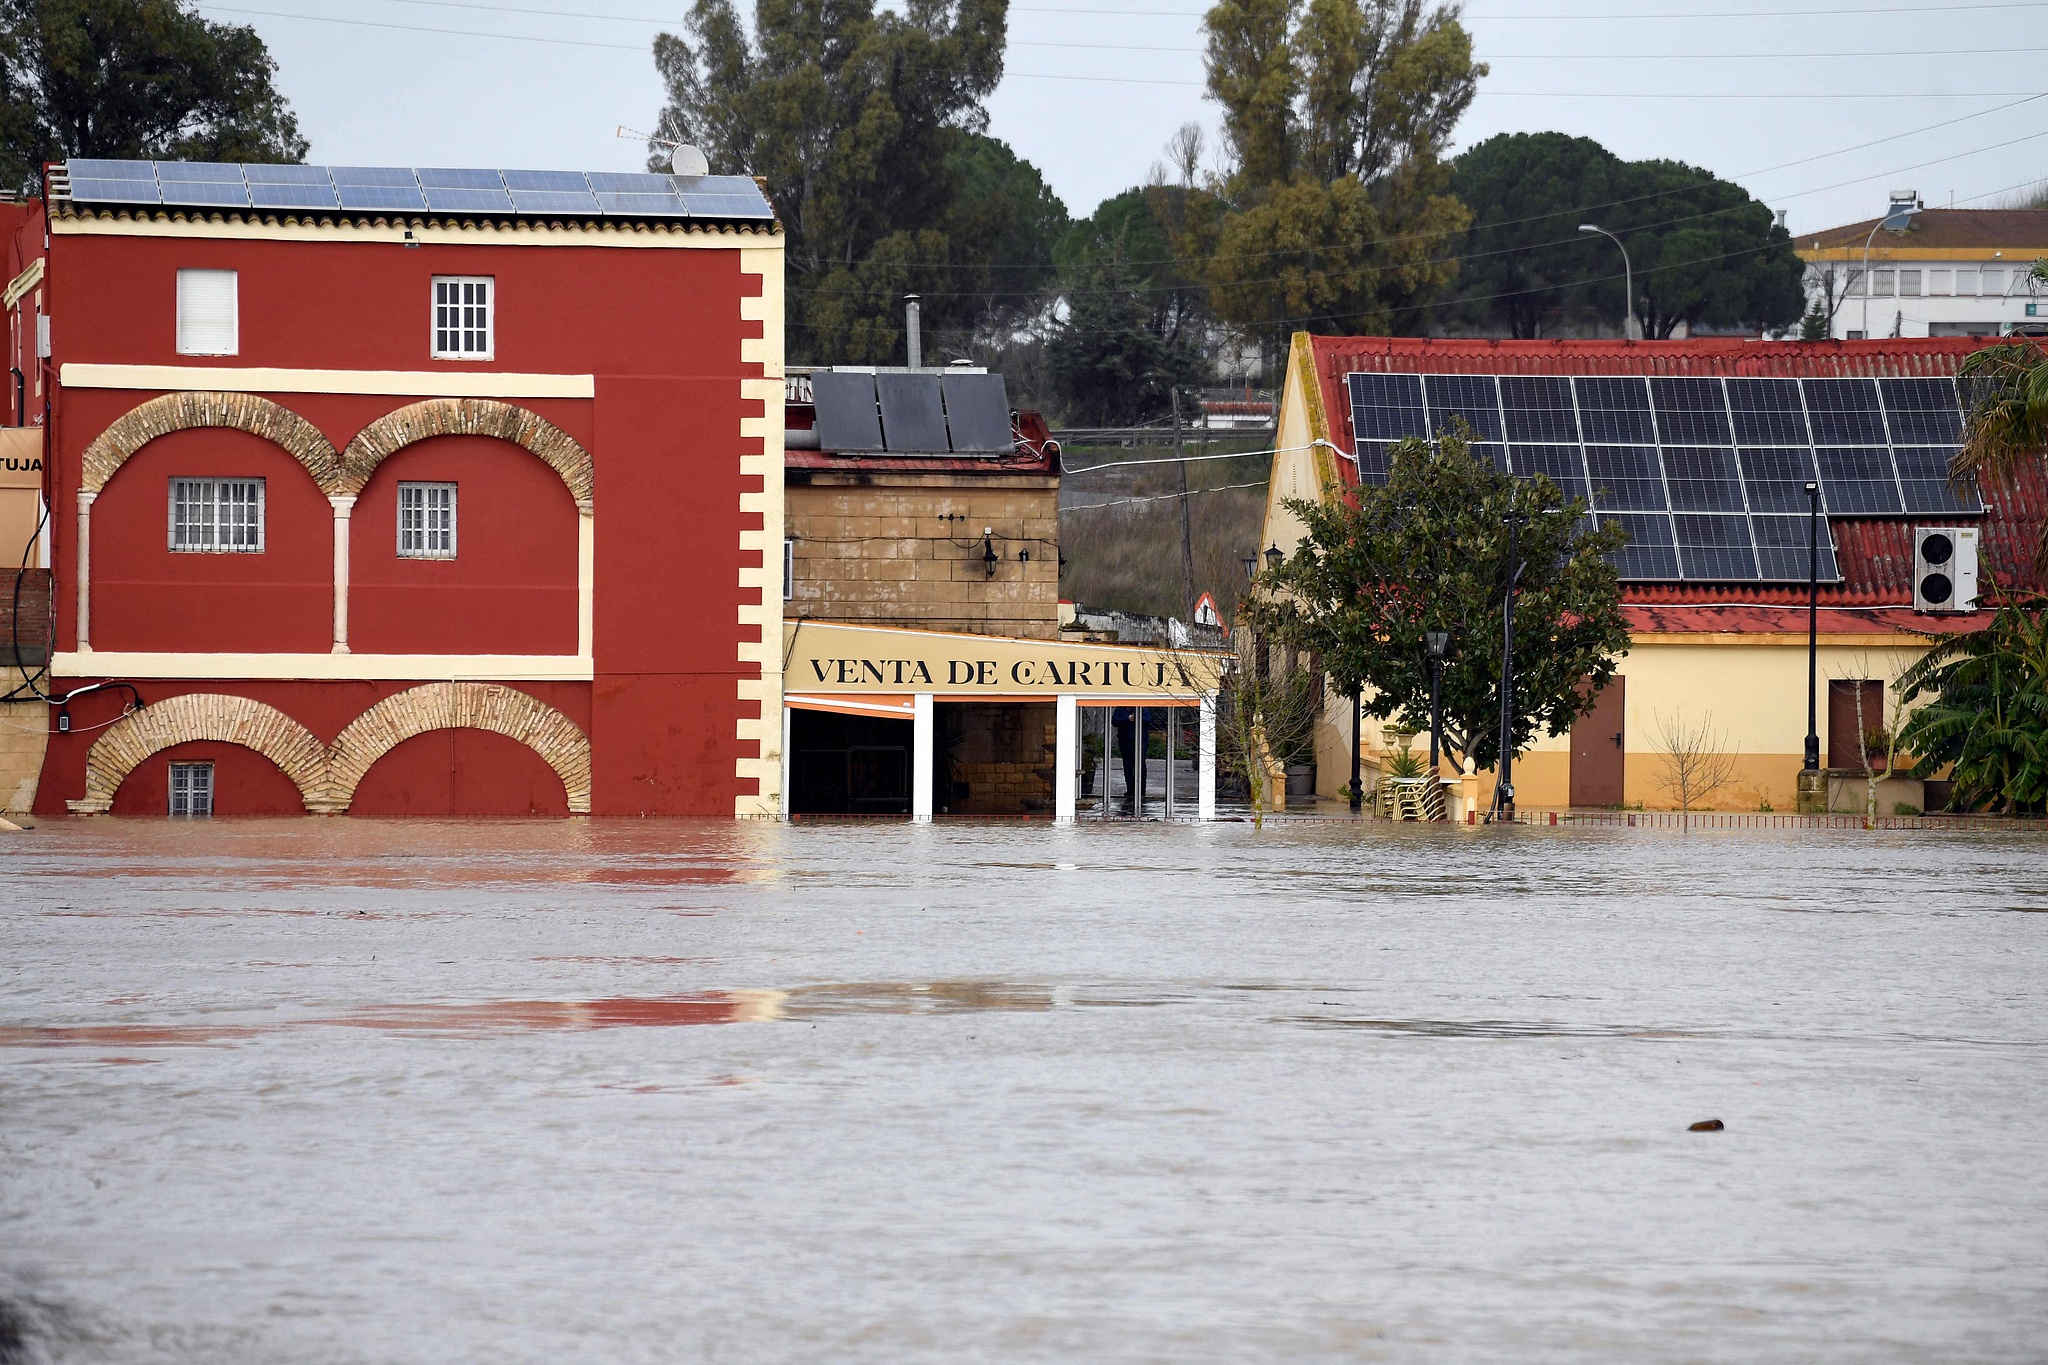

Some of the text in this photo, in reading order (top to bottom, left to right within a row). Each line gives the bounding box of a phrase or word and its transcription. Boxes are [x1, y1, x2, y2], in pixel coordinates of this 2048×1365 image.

[810, 659, 1192, 687] VENTA DE CARTUJA
